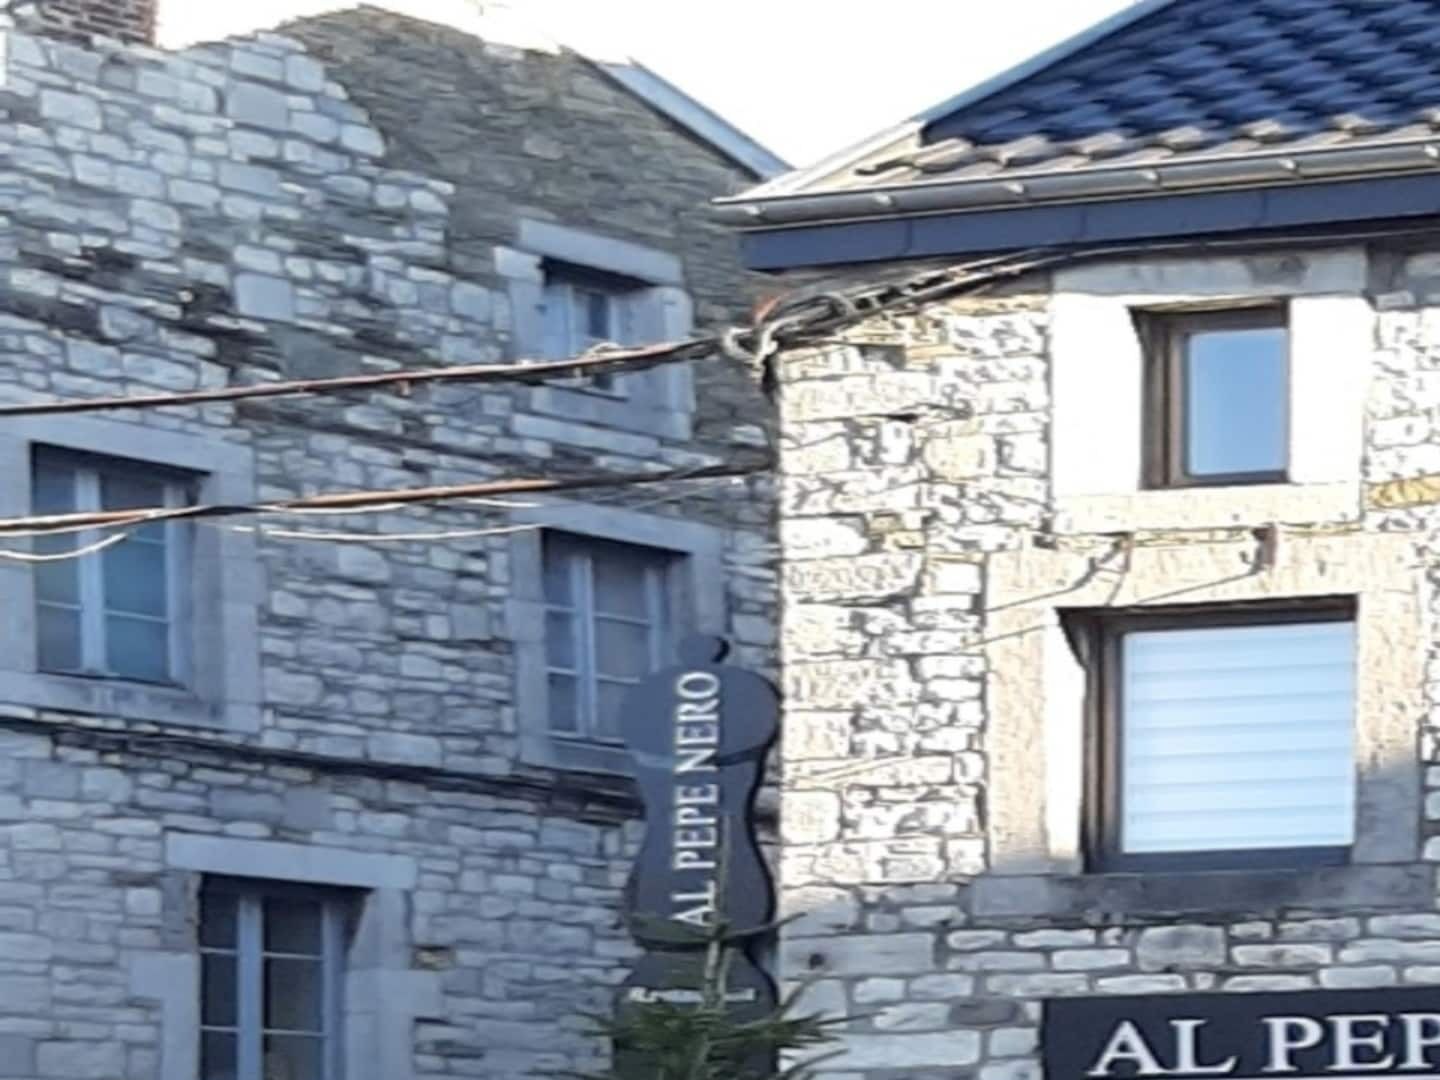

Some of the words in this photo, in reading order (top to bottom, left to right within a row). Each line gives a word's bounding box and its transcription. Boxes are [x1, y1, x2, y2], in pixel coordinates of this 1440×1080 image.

[673, 671, 721, 773] NERO
[672, 783, 719, 871] PEPE
[672, 880, 718, 927] AL
[1087, 1018, 1238, 1077] AL
